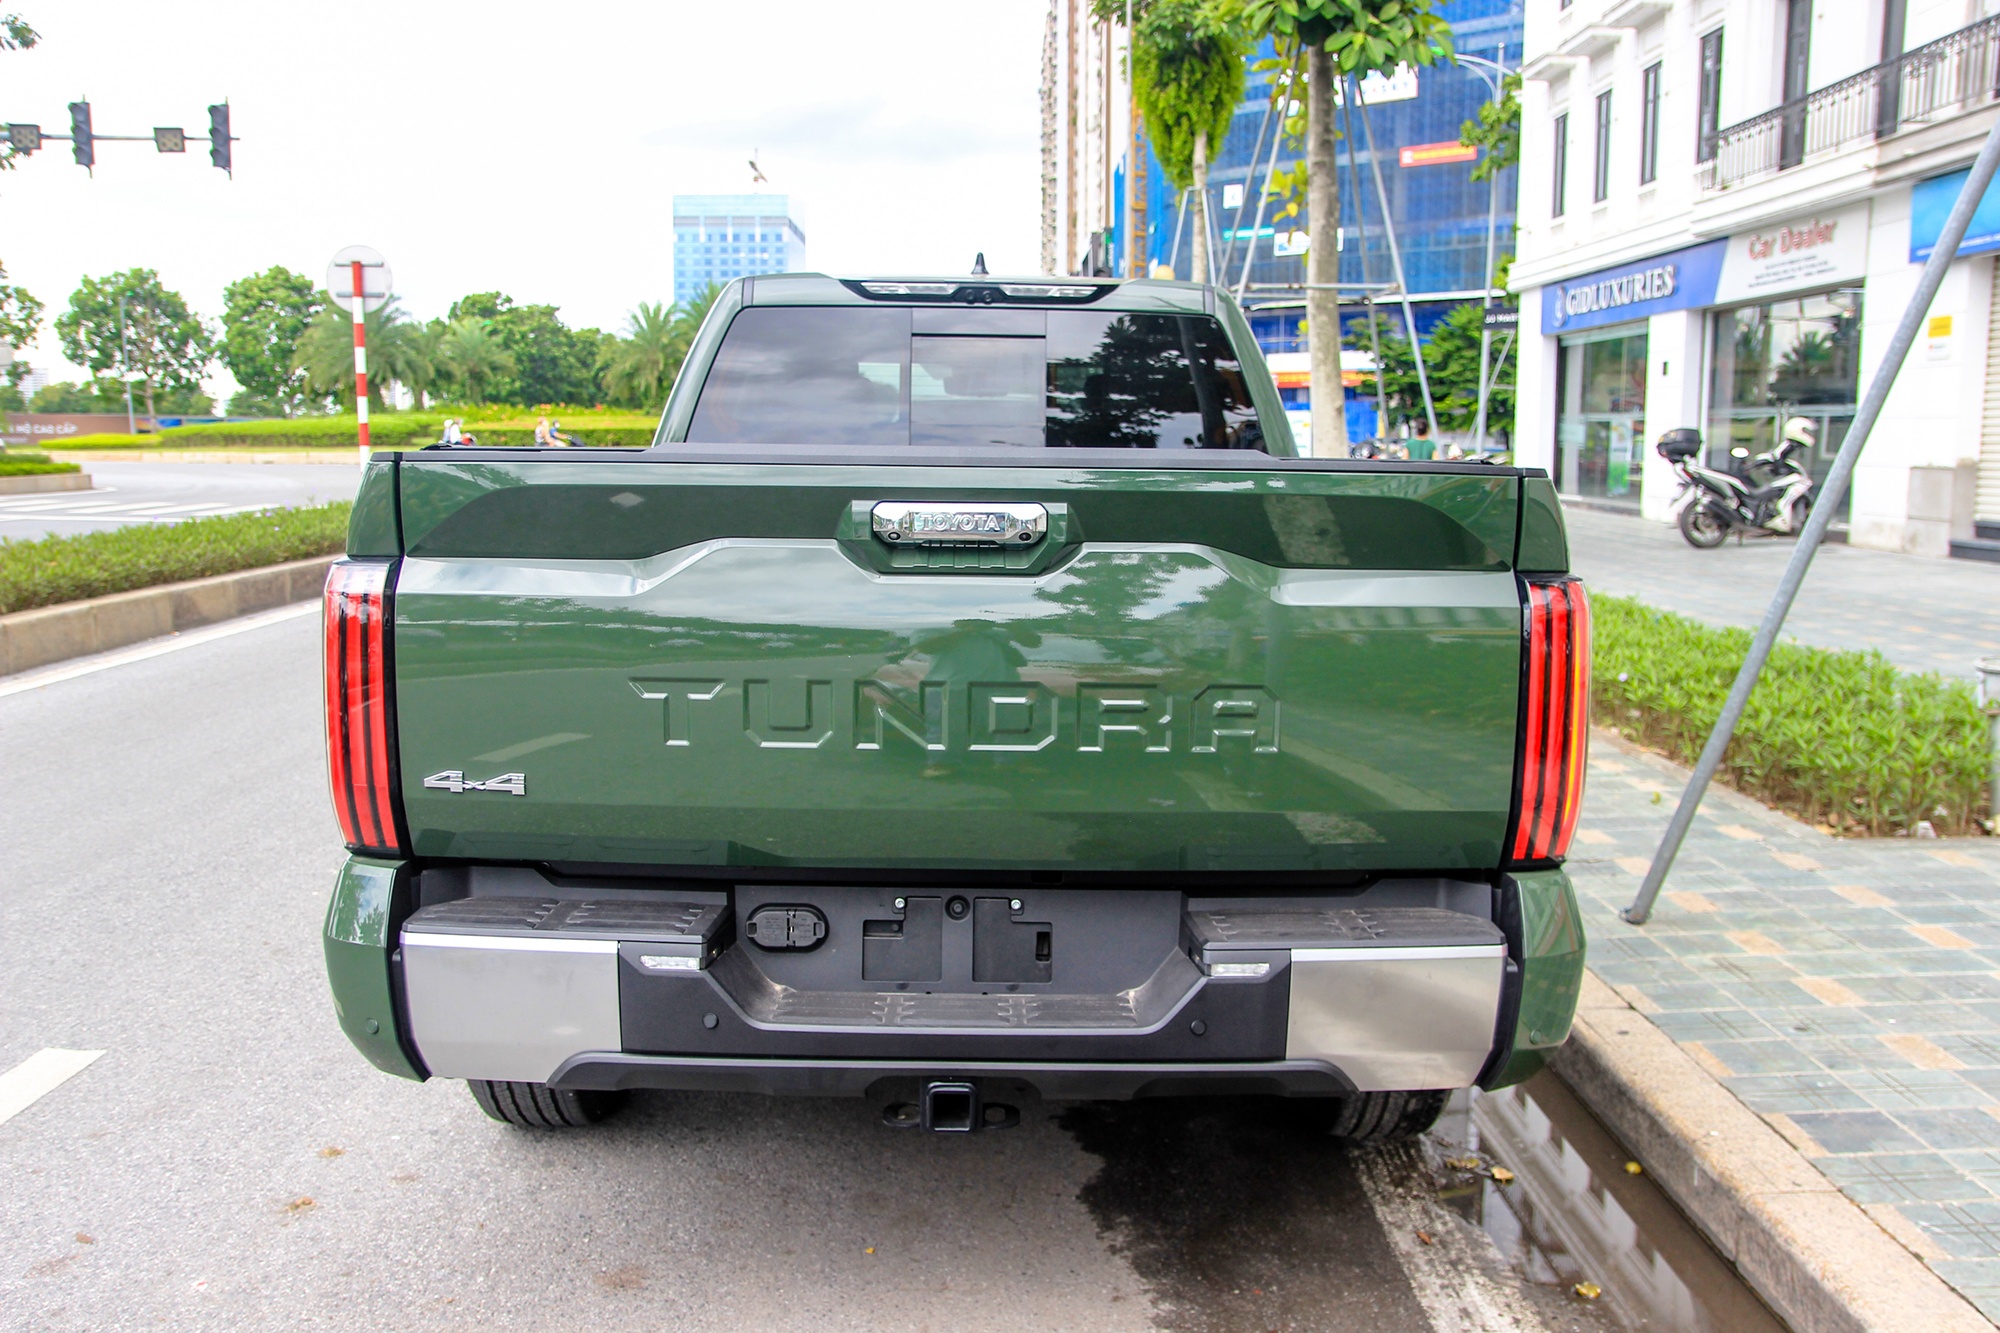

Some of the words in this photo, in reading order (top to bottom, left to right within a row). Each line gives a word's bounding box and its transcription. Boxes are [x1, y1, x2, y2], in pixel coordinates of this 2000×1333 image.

[1748, 234, 1775, 261] Car
[1780, 217, 1837, 253] Dealer
[1565, 264, 1676, 316] GIDLUXURIES
[919, 513, 1001, 532] TOYOTA
[628, 676, 1282, 753] TUNDRA
